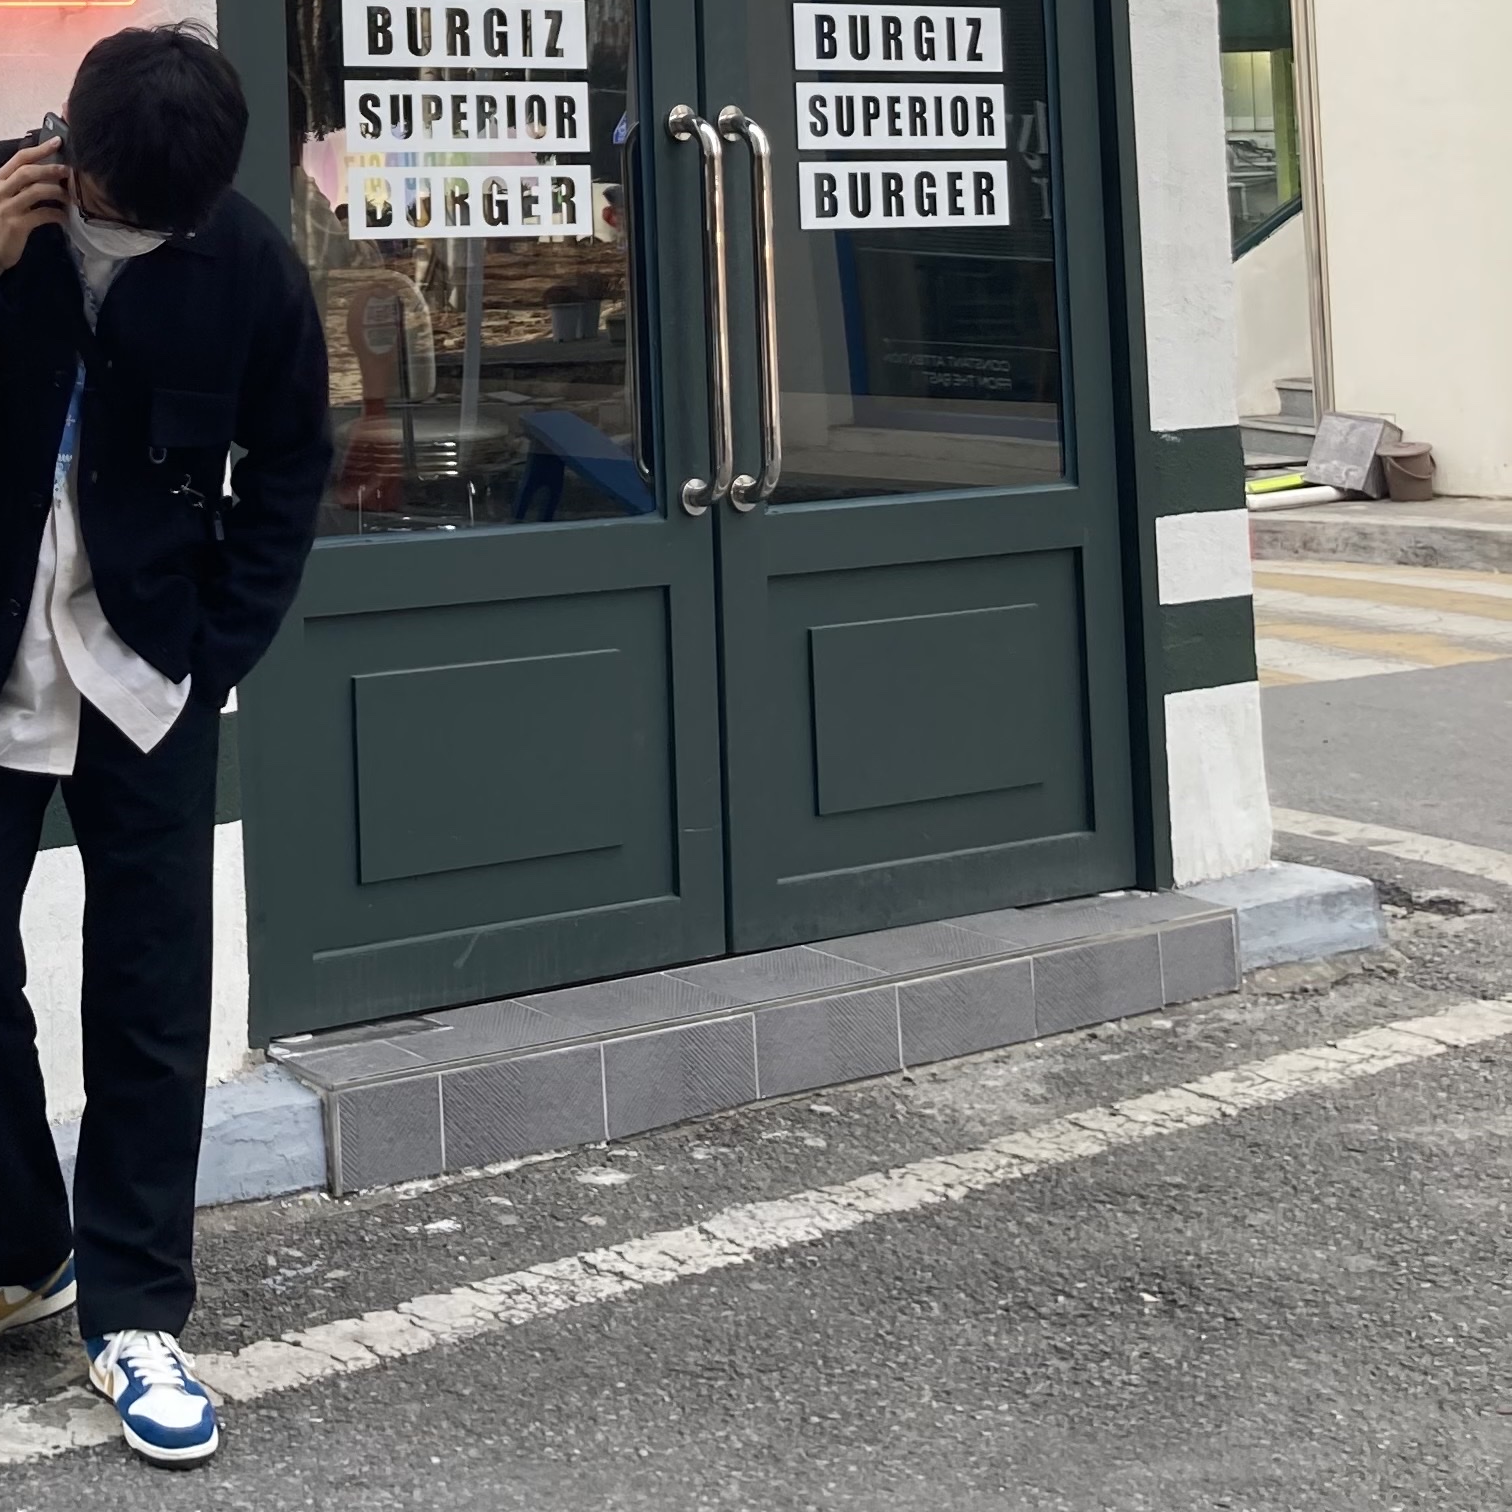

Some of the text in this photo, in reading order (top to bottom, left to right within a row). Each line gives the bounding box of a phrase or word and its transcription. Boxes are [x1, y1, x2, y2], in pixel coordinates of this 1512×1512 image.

[366, 5, 565, 58] BURGIZ
[814, 13, 984, 62] BURGIZ
[358, 92, 578, 141] SUPERIOR
[808, 93, 996, 138] SUPERIOR
[364, 175, 577, 229] BURGER
[813, 170, 996, 219] BURGER
